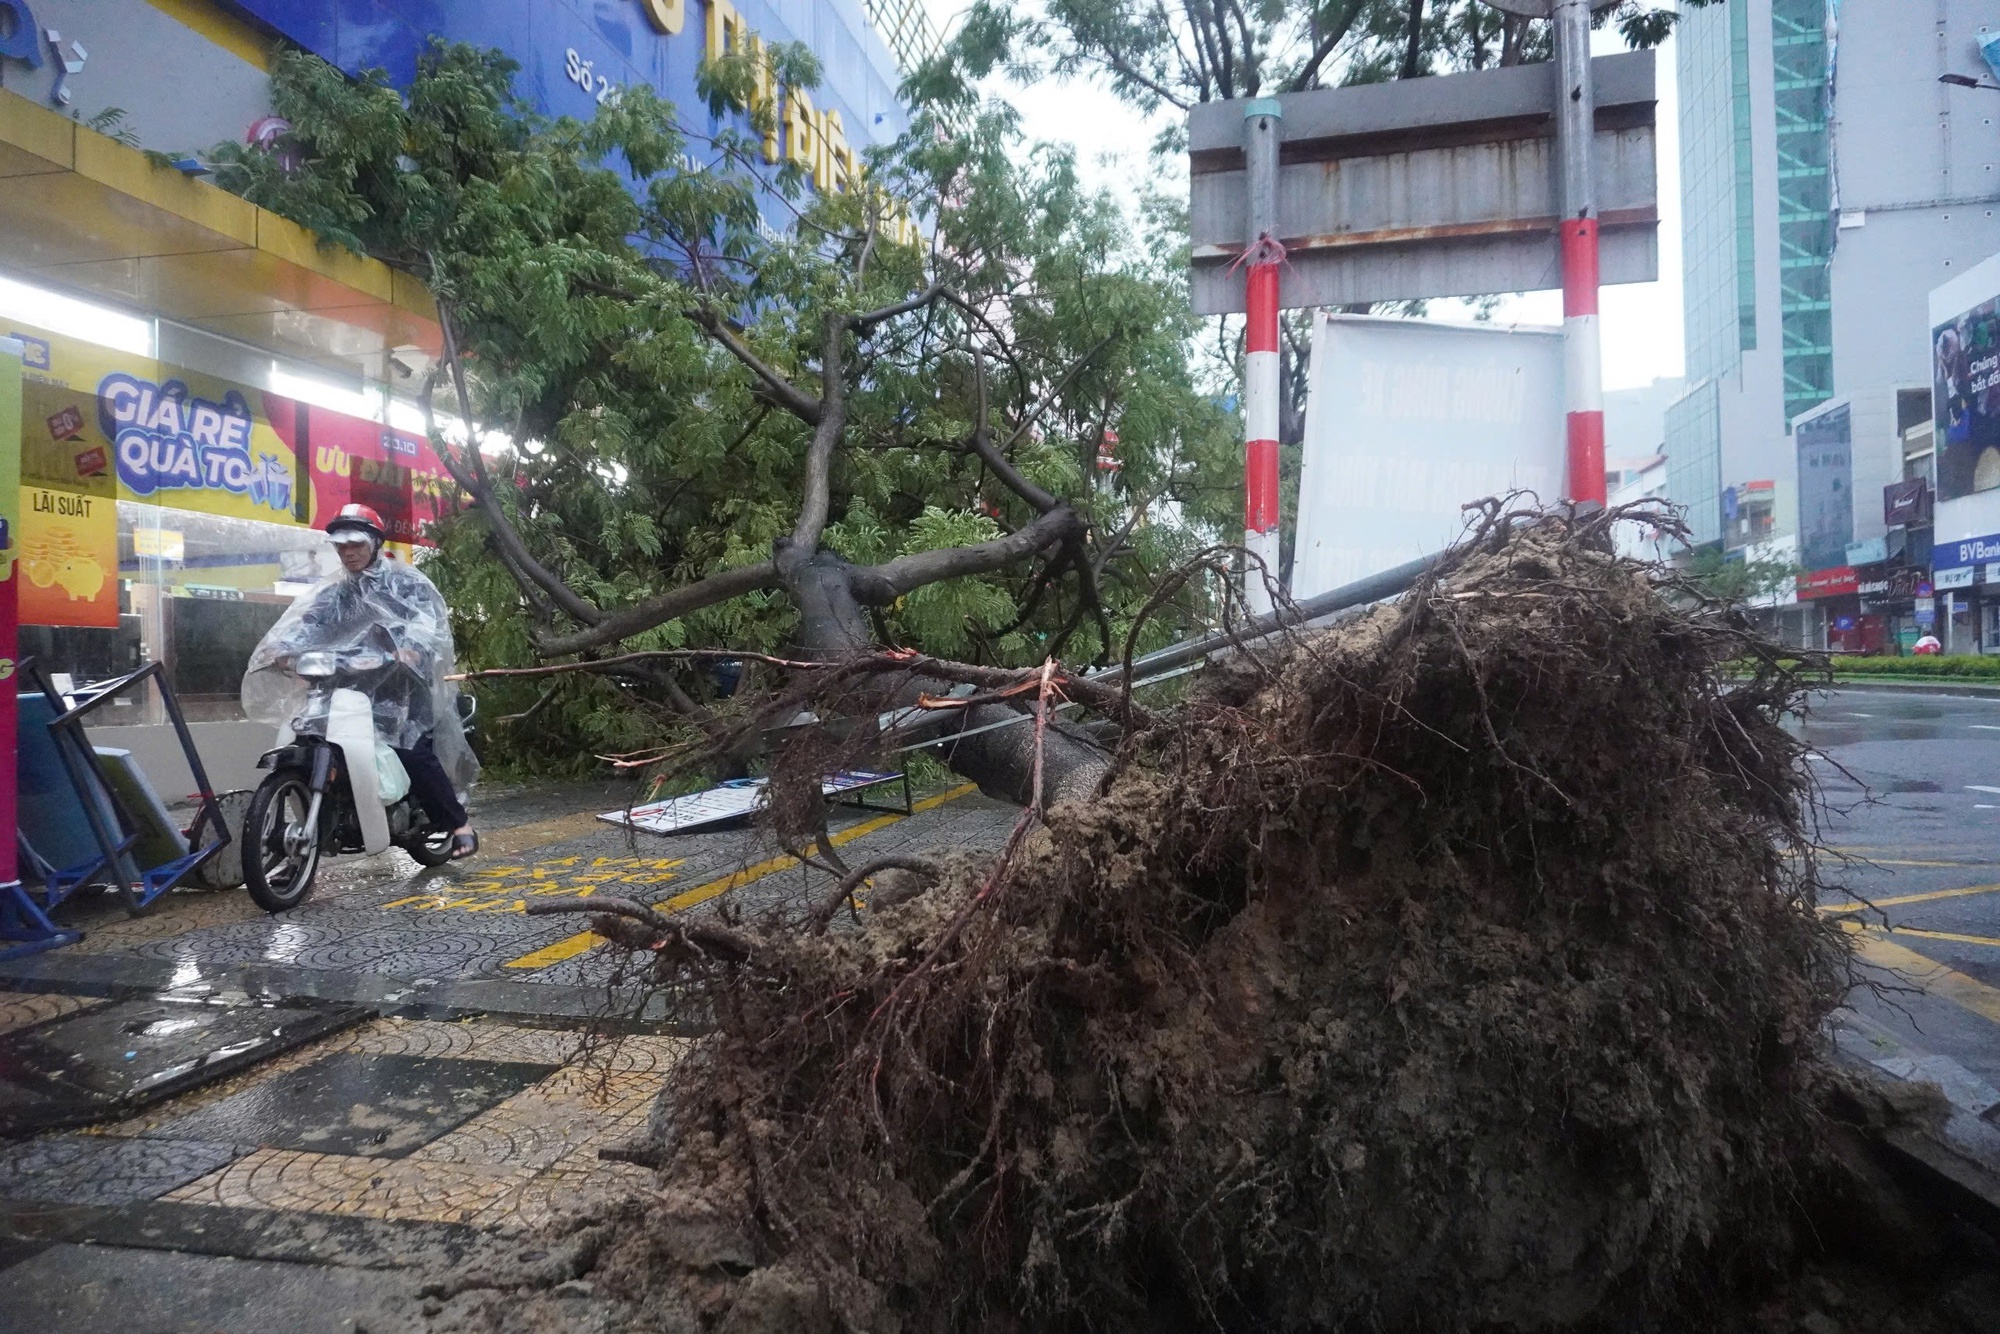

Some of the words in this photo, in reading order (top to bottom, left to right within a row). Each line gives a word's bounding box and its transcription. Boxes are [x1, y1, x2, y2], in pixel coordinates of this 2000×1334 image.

[565, 47, 594, 92] Số
[105, 381, 180, 436] GIÁ
[193, 403, 247, 448] RẺ
[120, 436, 198, 479] QUÀ
[206, 453, 250, 487] TO
[33, 490, 55, 514] LÃI
[58, 494, 92, 518] SUẤT
